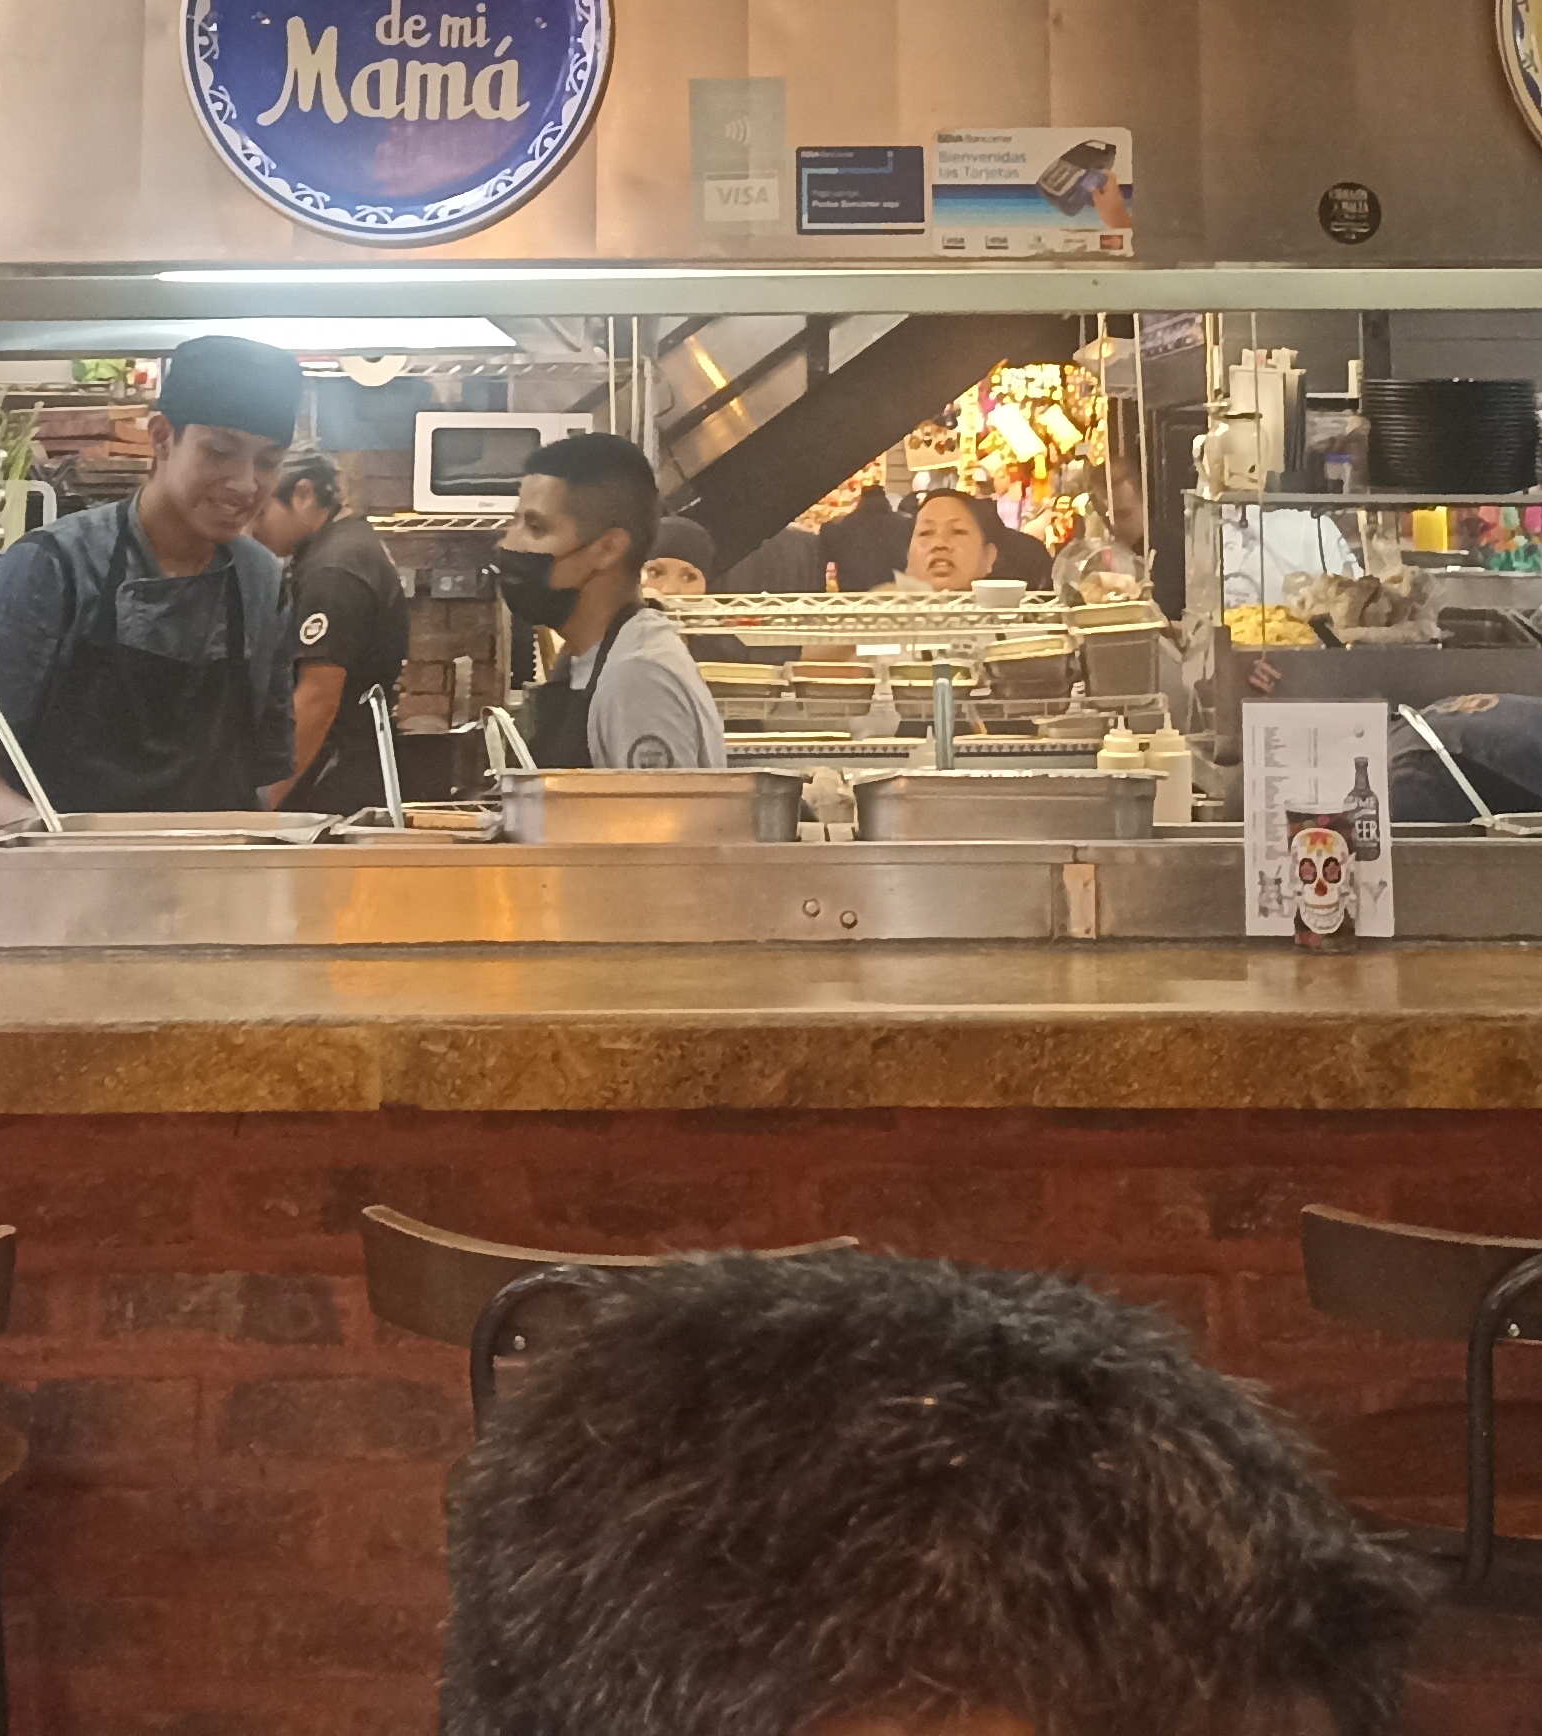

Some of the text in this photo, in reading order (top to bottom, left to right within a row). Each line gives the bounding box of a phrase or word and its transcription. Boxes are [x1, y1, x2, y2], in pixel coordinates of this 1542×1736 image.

[439, 2, 491, 48] mi
[256, 15, 531, 126] Mamá
[716, 184, 770, 206] VISA
